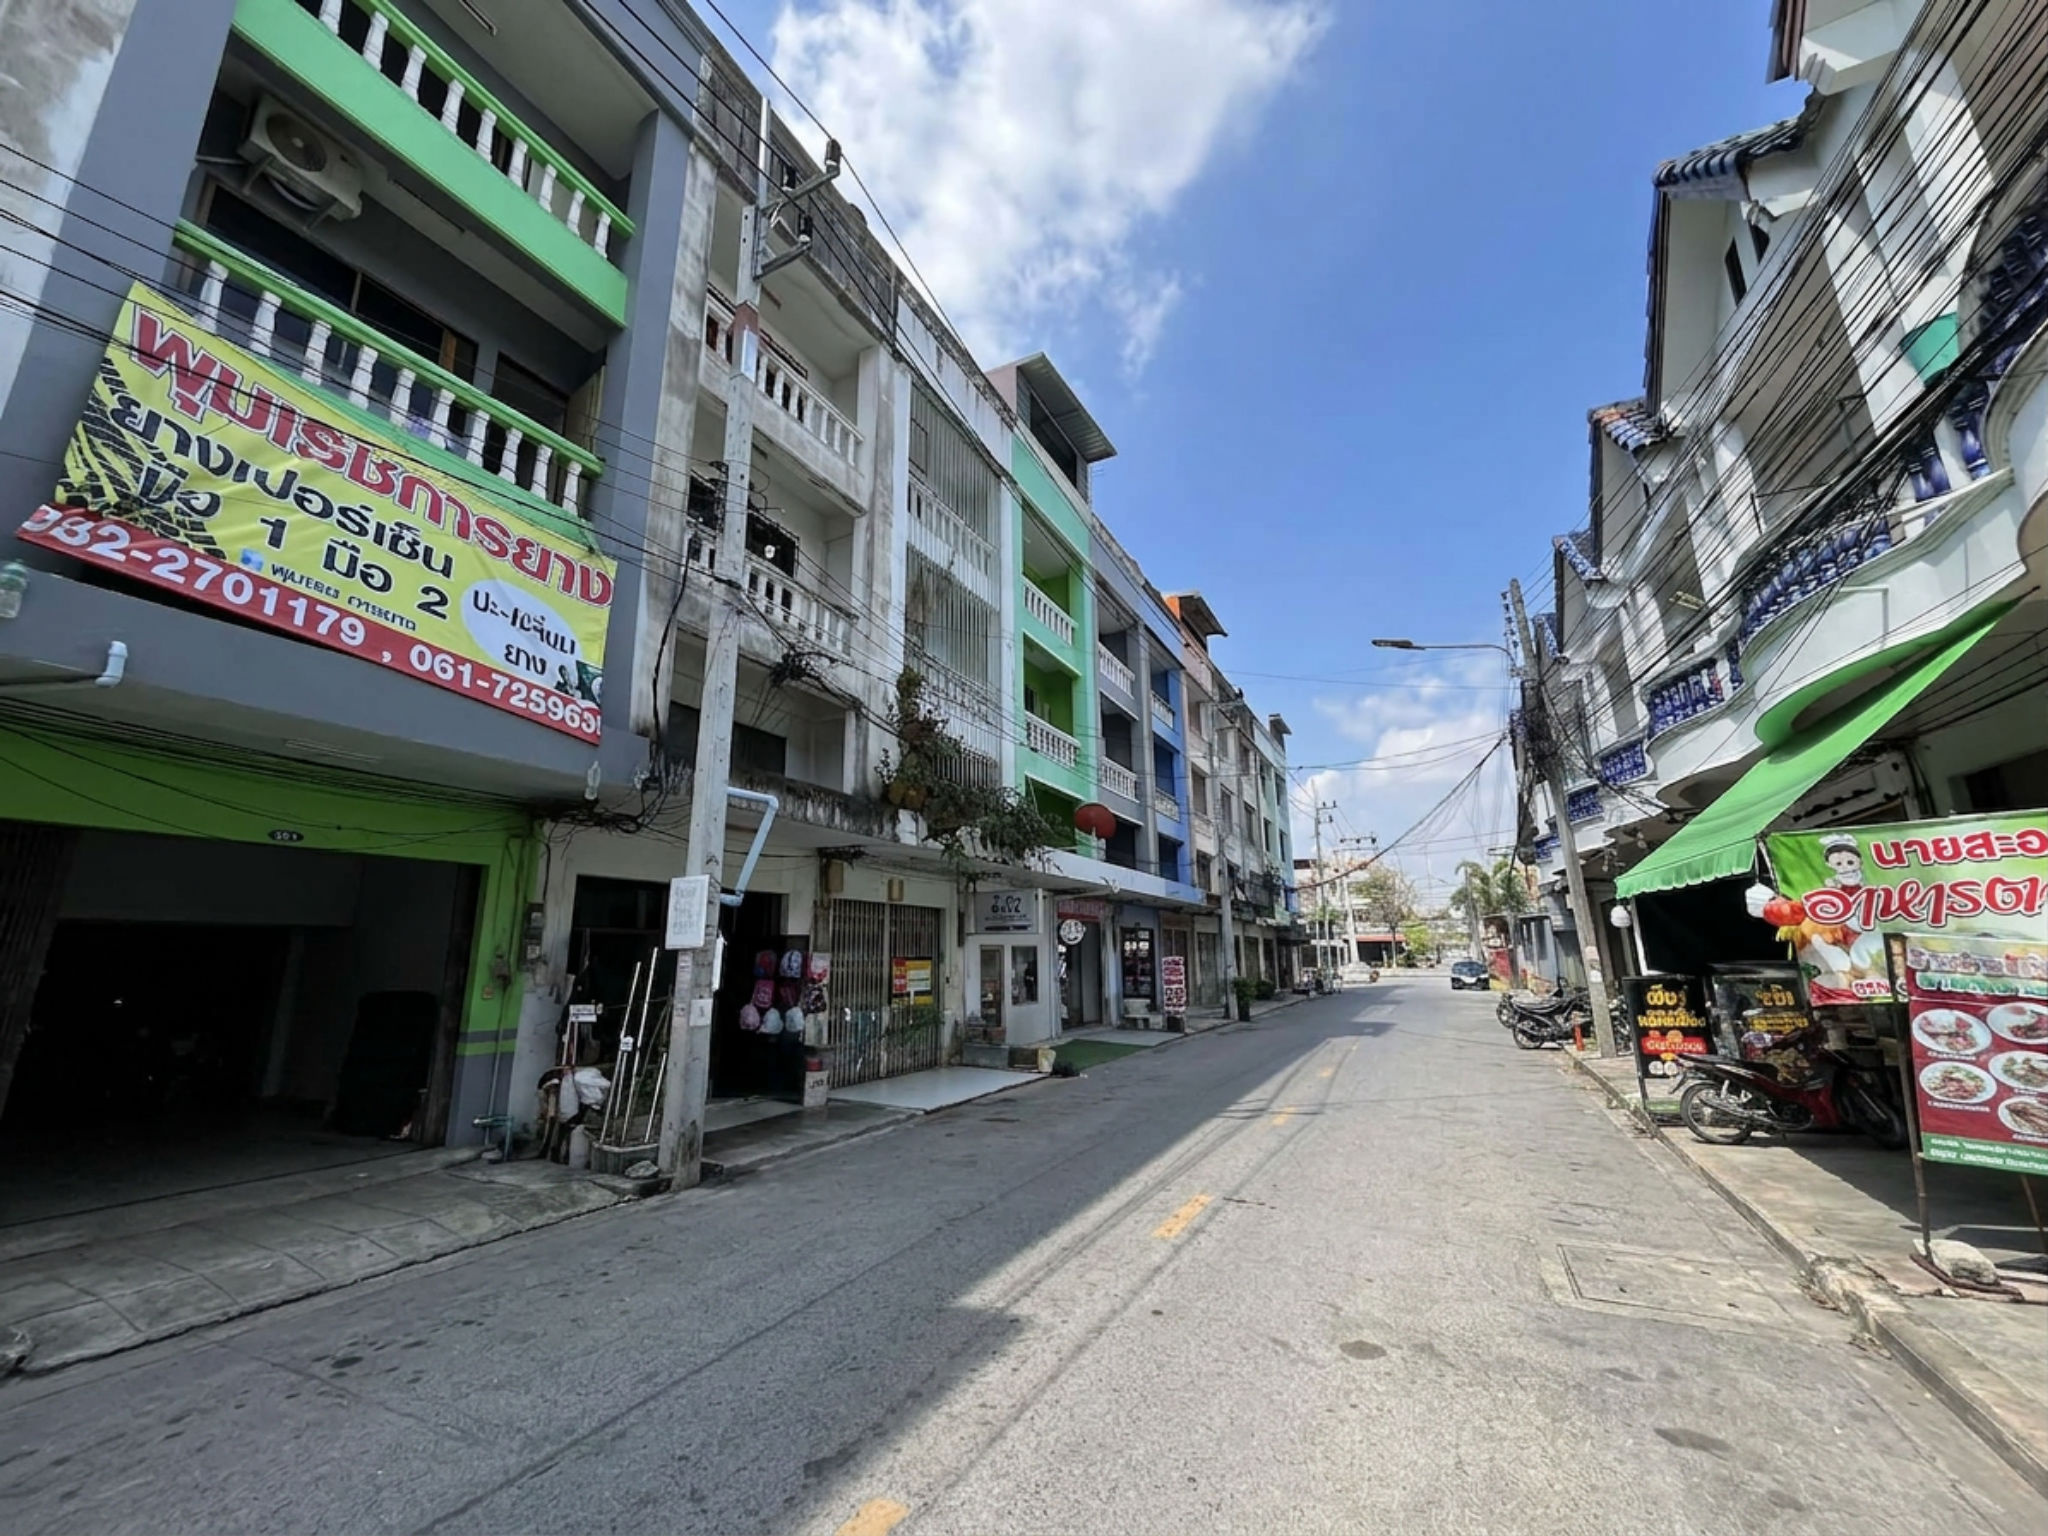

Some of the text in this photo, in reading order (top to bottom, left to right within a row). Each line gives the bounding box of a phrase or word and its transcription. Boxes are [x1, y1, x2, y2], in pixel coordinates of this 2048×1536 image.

[259, 517, 288, 551] 1
[321, 538, 394, 595] มือ
[416, 585, 451, 621] 2
[505, 643, 548, 675] ยาง
